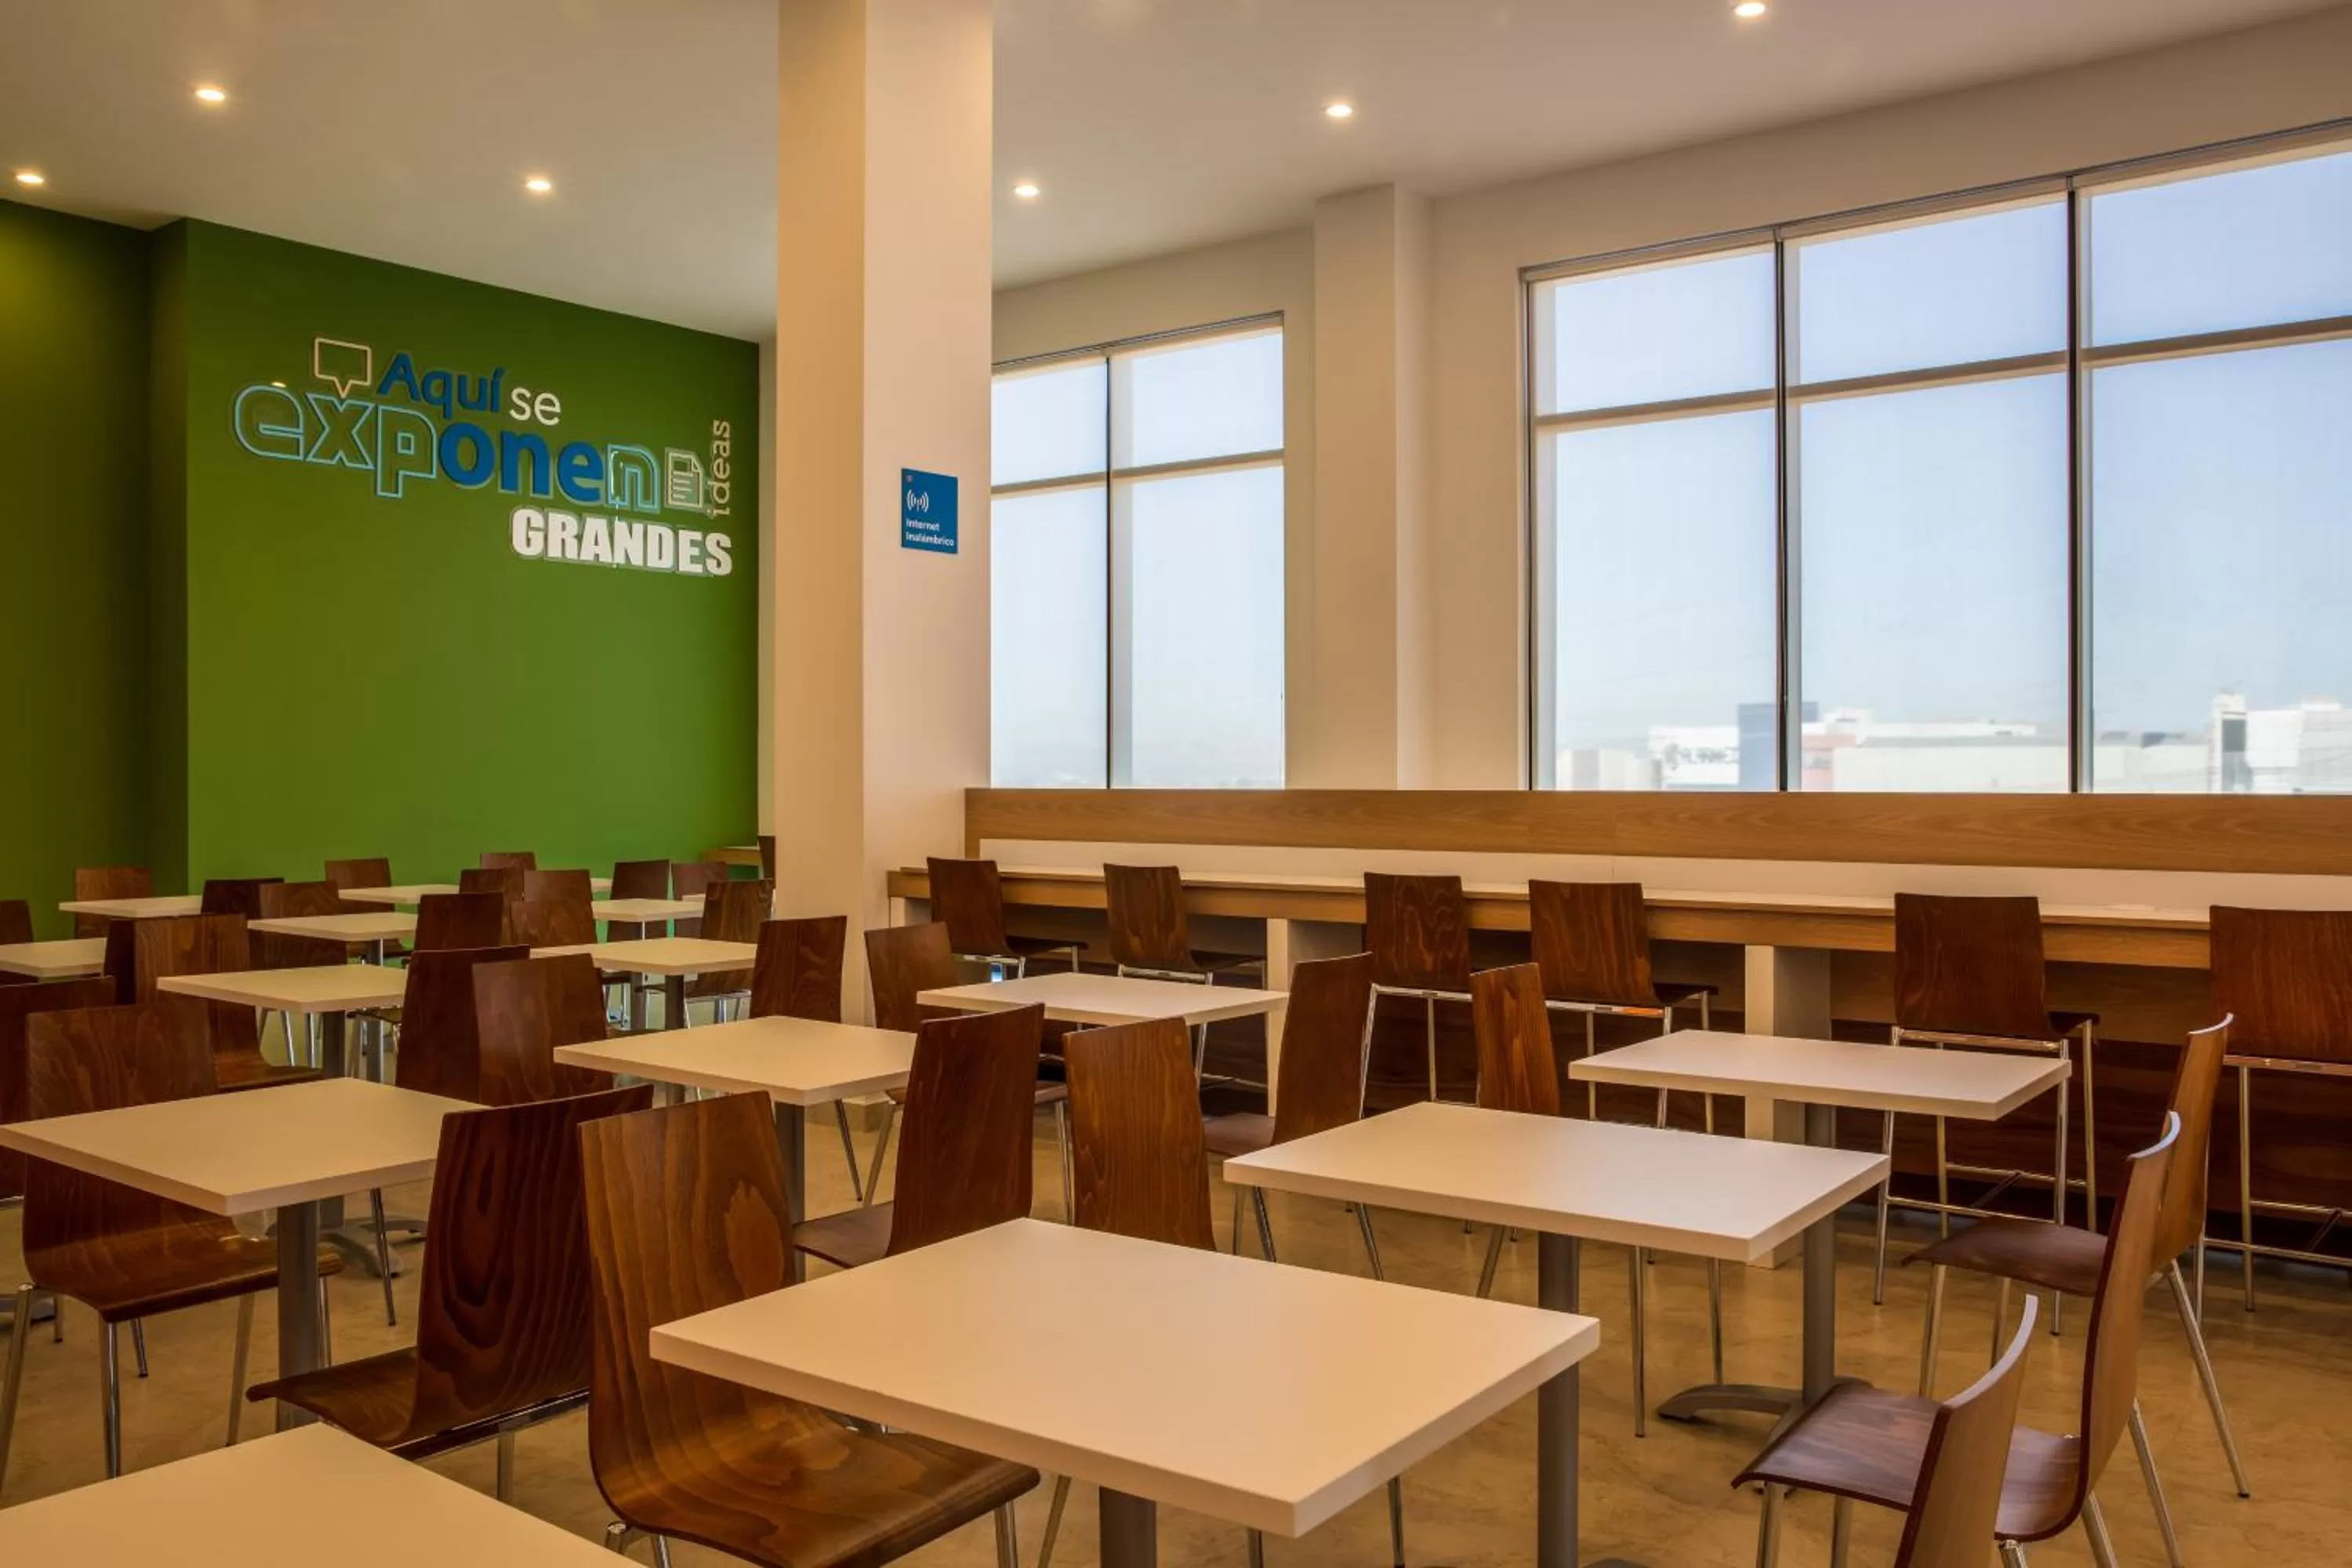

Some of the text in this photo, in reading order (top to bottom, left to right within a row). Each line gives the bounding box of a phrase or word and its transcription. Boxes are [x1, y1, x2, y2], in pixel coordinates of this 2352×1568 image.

[376, 353, 561, 425] Aquí se
[235, 386, 660, 513] exponen
[706, 419, 730, 517] ideas
[511, 507, 732, 575] GRANDES
[906, 518, 940, 531] Internet
